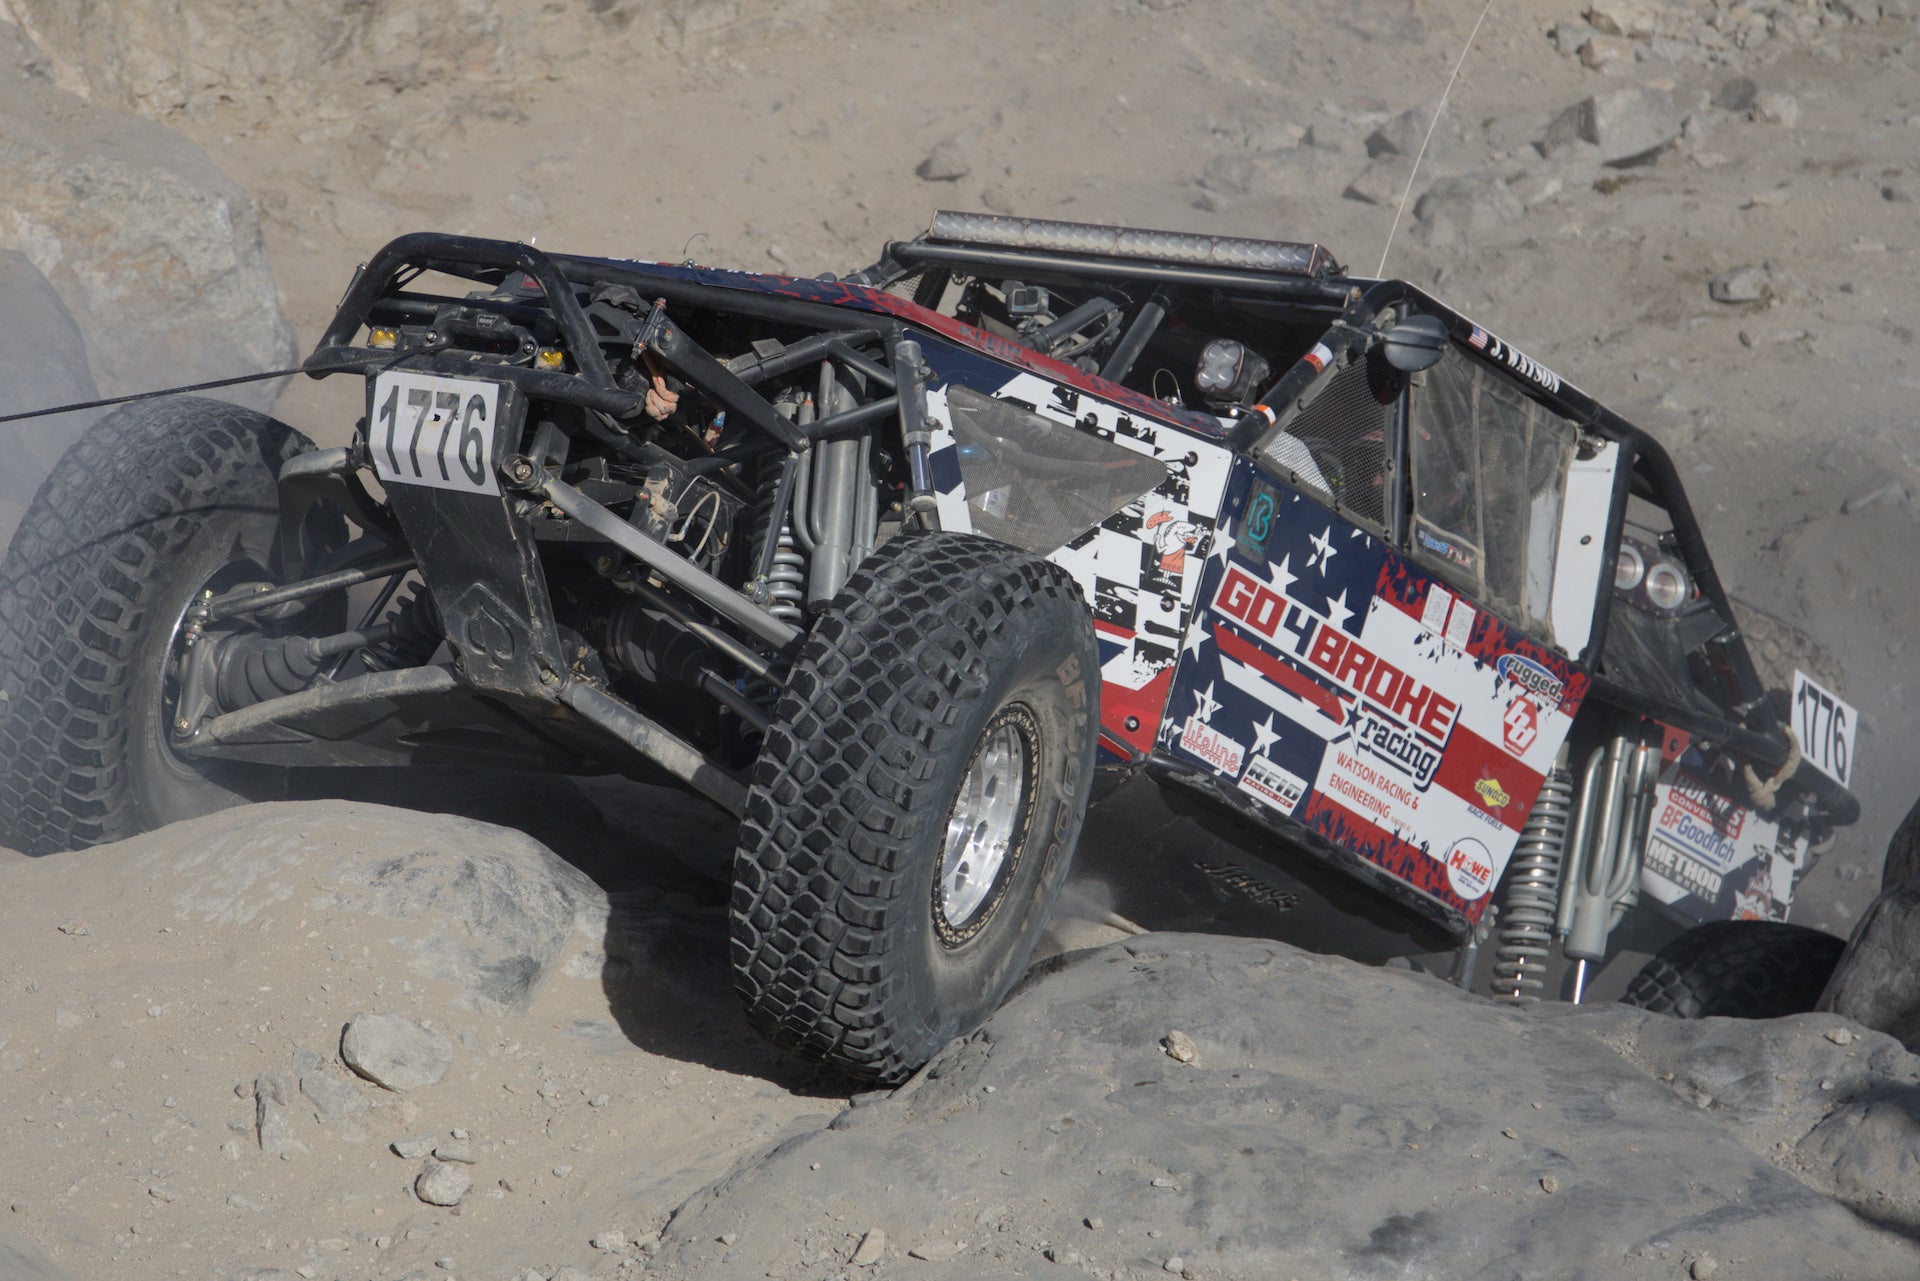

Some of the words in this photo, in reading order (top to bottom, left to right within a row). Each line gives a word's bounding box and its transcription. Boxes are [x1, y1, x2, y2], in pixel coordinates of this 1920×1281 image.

[379, 384, 487, 487] 1776
[1361, 714, 1437, 782] racing
[1798, 679, 1847, 784] 1776
[1247, 762, 1303, 801] REID
[1328, 773, 1391, 819] ENGINEERING
[1336, 751, 1378, 785] WATSON
[1376, 775, 1412, 806] RACING
[1411, 796, 1420, 811] &
[1476, 780, 1509, 806] SUNOCO
[1467, 804, 1485, 820] RACE
[1484, 815, 1503, 831] FUELS
[1660, 804, 1735, 863] BFGoodrich
[1645, 858, 1672, 878] RACE
[1675, 873, 1718, 904] WHEELS
[1647, 838, 1722, 894] METHOD
